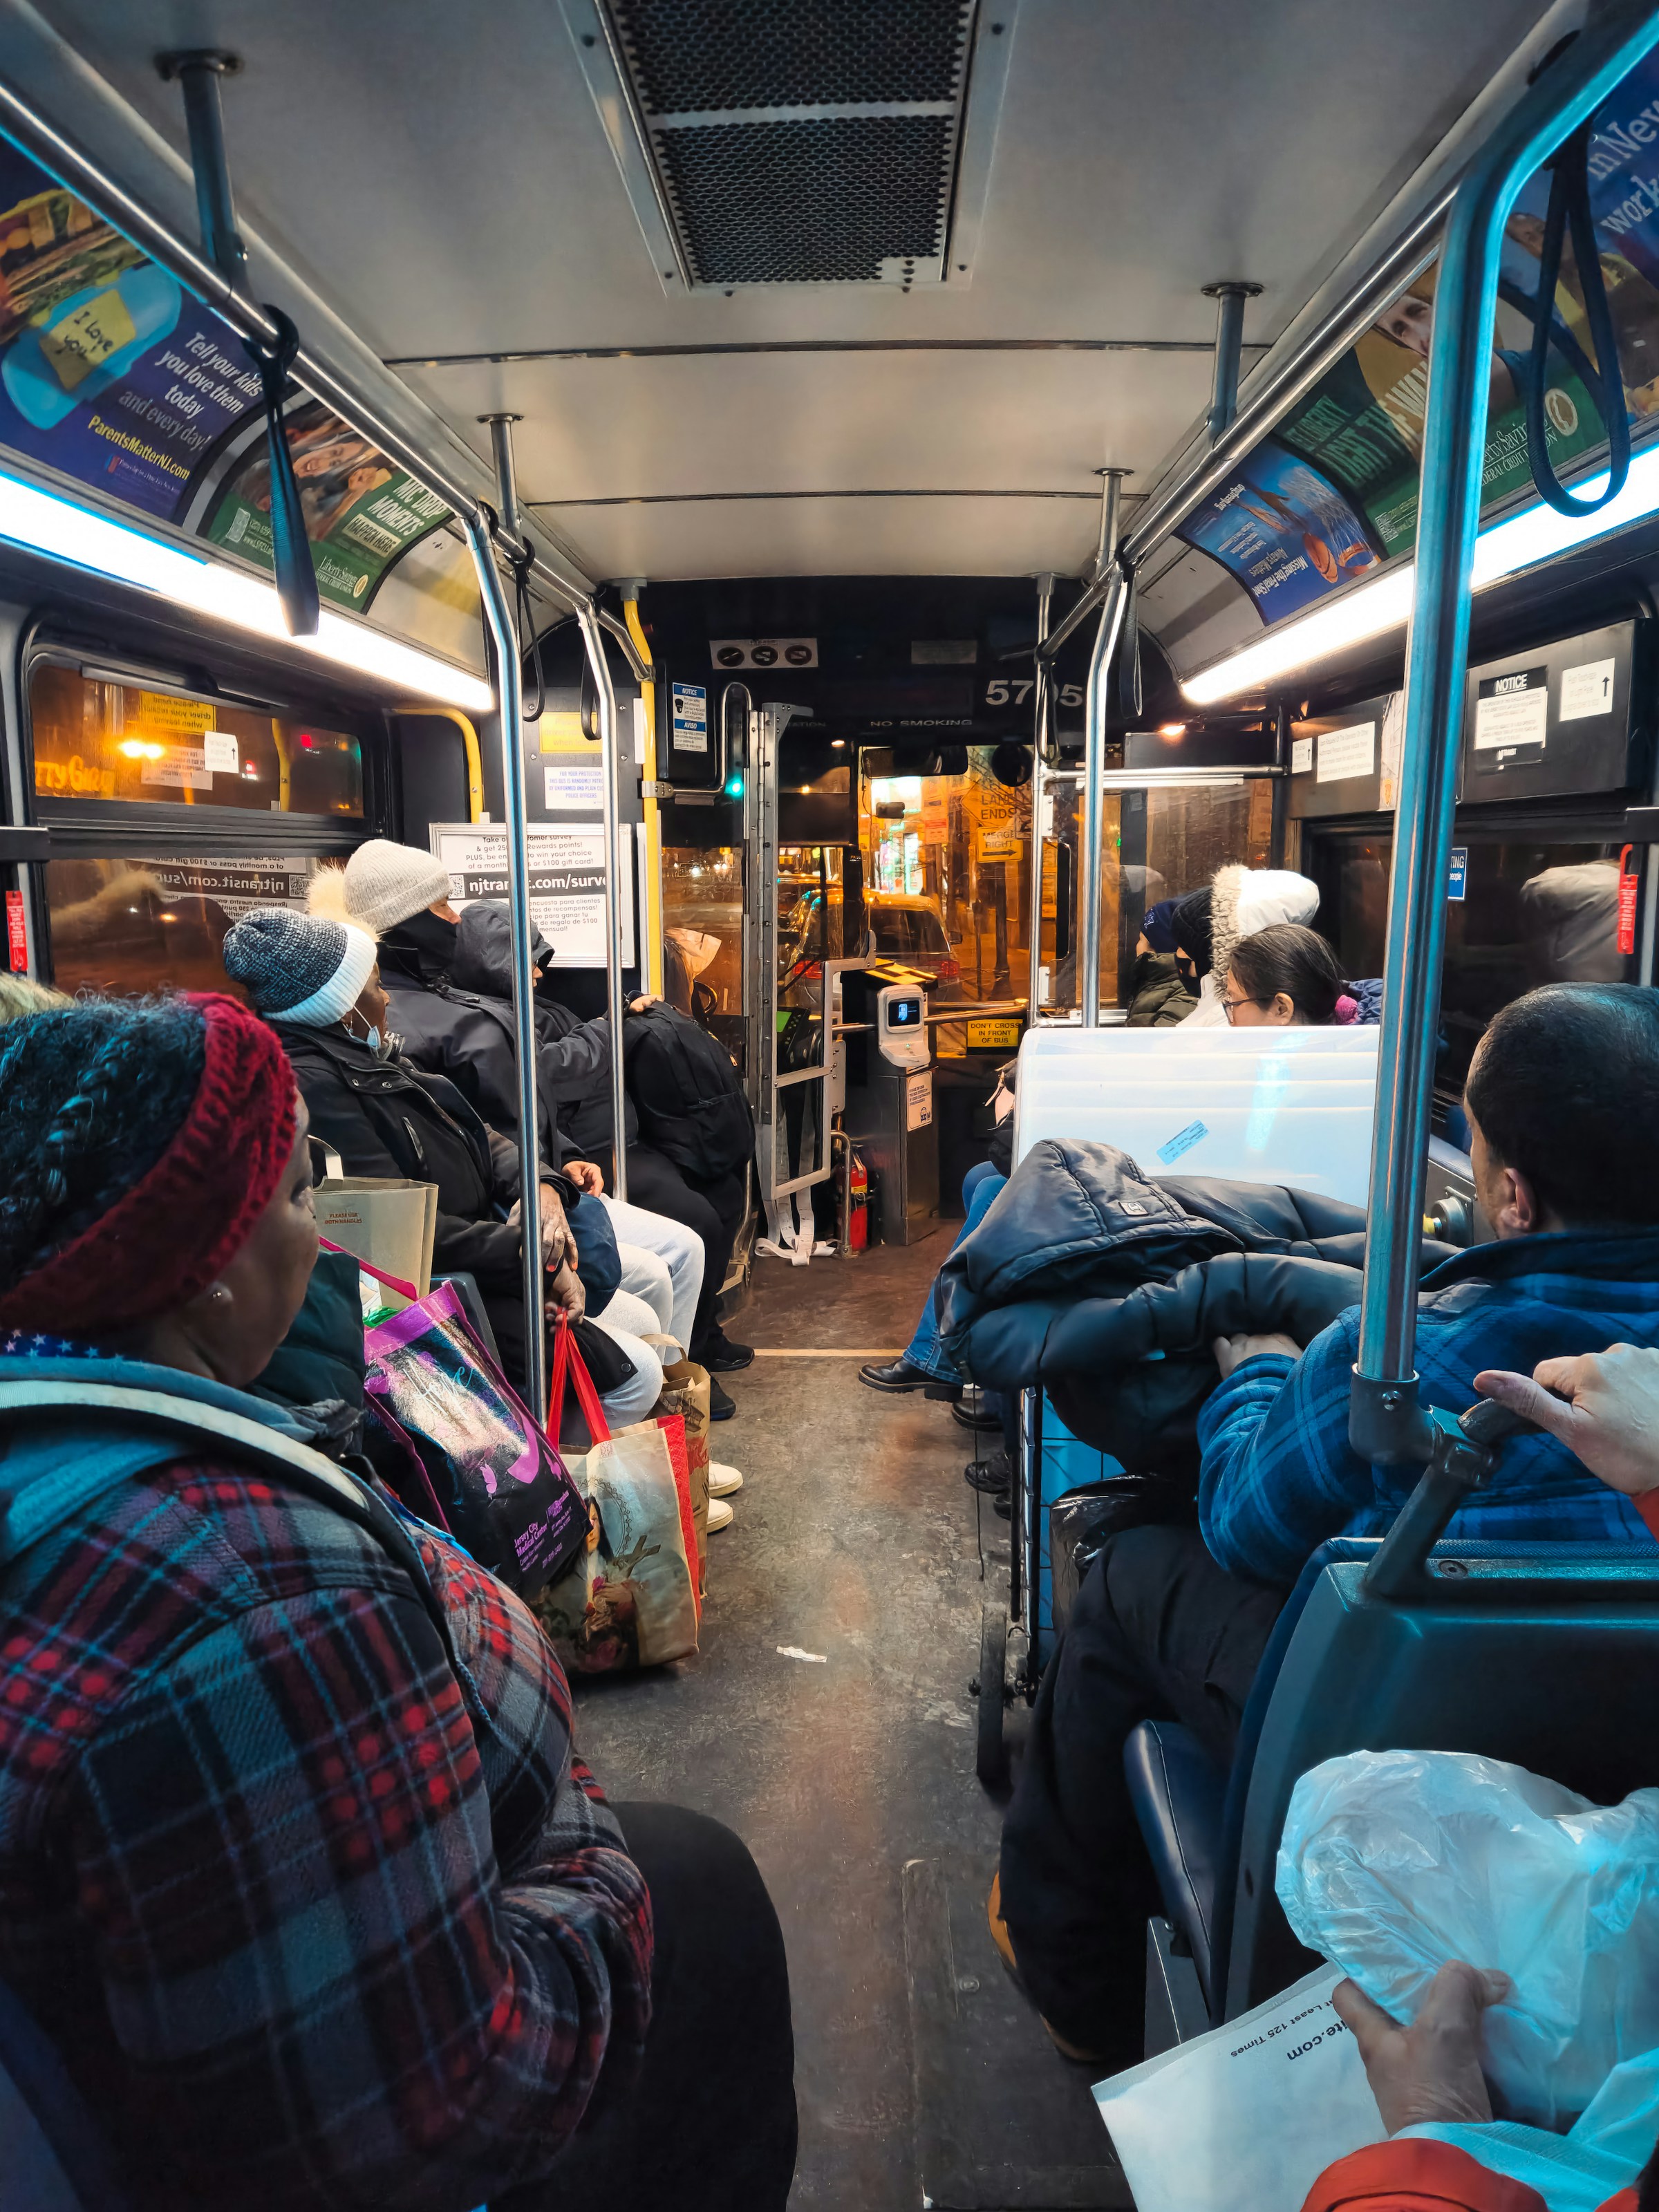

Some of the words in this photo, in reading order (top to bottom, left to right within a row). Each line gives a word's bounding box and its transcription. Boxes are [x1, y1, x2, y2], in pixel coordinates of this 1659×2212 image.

[73, 311, 90, 324] I
[84, 320, 114, 353] love
[56, 335, 88, 358] you
[185, 332, 215, 360] Tell
[202, 349, 241, 378] your
[234, 371, 263, 398] kids
[154, 350, 189, 375] you
[185, 365, 214, 393] love
[209, 384, 245, 414] them
[164, 384, 205, 420] today
[119, 391, 152, 415] and
[147, 406, 184, 438] every
[180, 426, 212, 453] day!
[88, 415, 191, 480] ParentsMatterNJ.com
[393, 478, 425, 503] MIC
[411, 491, 449, 518] DROP
[367, 495, 425, 536] MOMENTS
[346, 517, 379, 547] HAPPEN
[373, 530, 397, 554] HERE
[1281, 555, 1309, 577] Missing
[1262, 574, 1280, 592] Final
[985, 679, 1083, 707] 575
[1494, 673, 1528, 692] NOTICE
[982, 807, 1017, 820] ENDS
[561, 859, 573, 868] gift
[514, 1530, 529, 1548] Jersey
[528, 1521, 538, 1534] City
[516, 1535, 535, 1557] Medical
[534, 1523, 547, 1540] Center
[1290, 2004, 1323, 2025] Least
[1267, 2023, 1288, 2038] 125
[1230, 2036, 1266, 2057] Times
